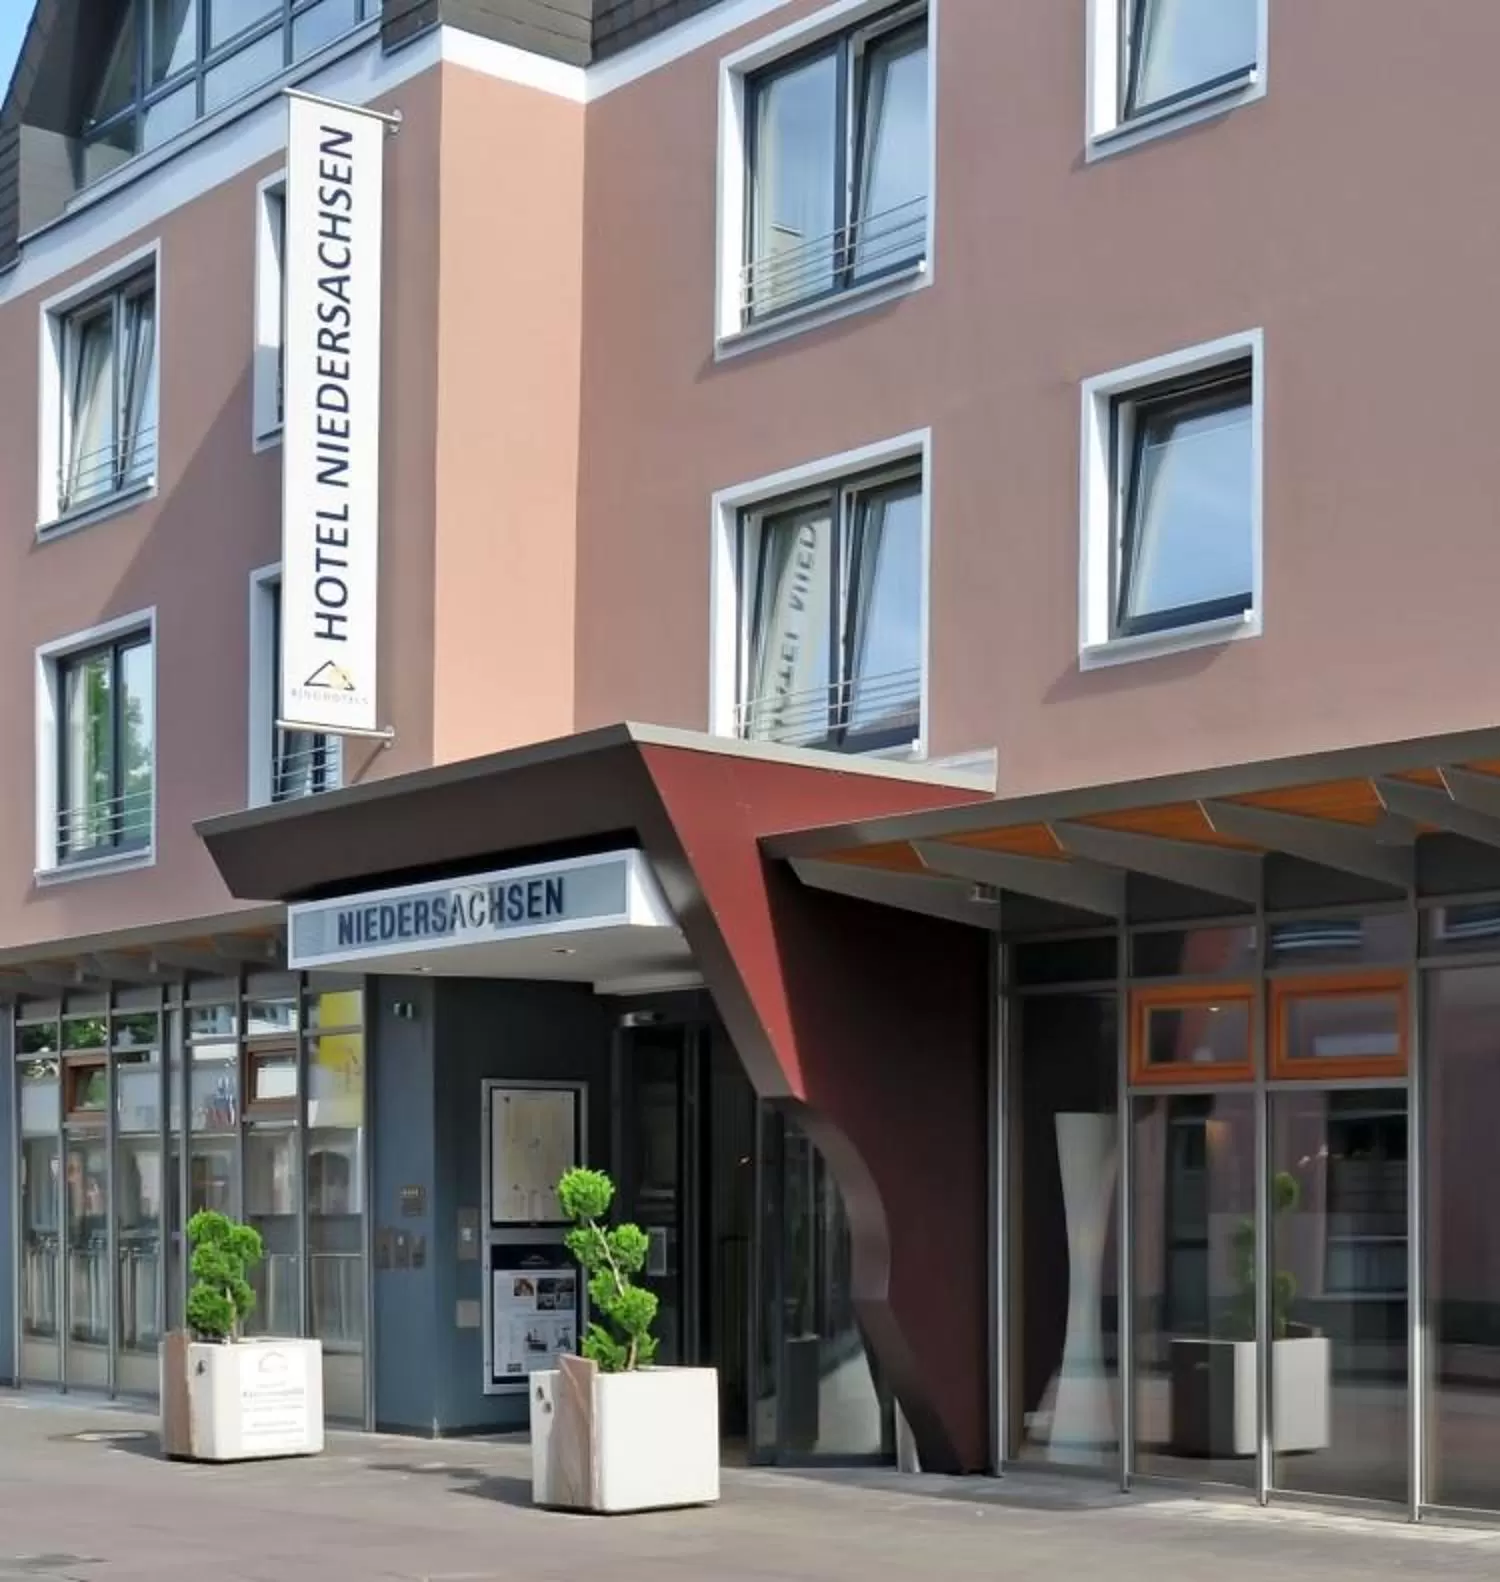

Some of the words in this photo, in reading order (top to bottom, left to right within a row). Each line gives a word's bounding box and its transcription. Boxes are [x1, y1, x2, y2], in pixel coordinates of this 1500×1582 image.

[317, 126, 353, 488] NIEDERSACHSEN
[315, 503, 349, 641] HOTEL
[338, 877, 563, 945] NIEDERSACHSEN
